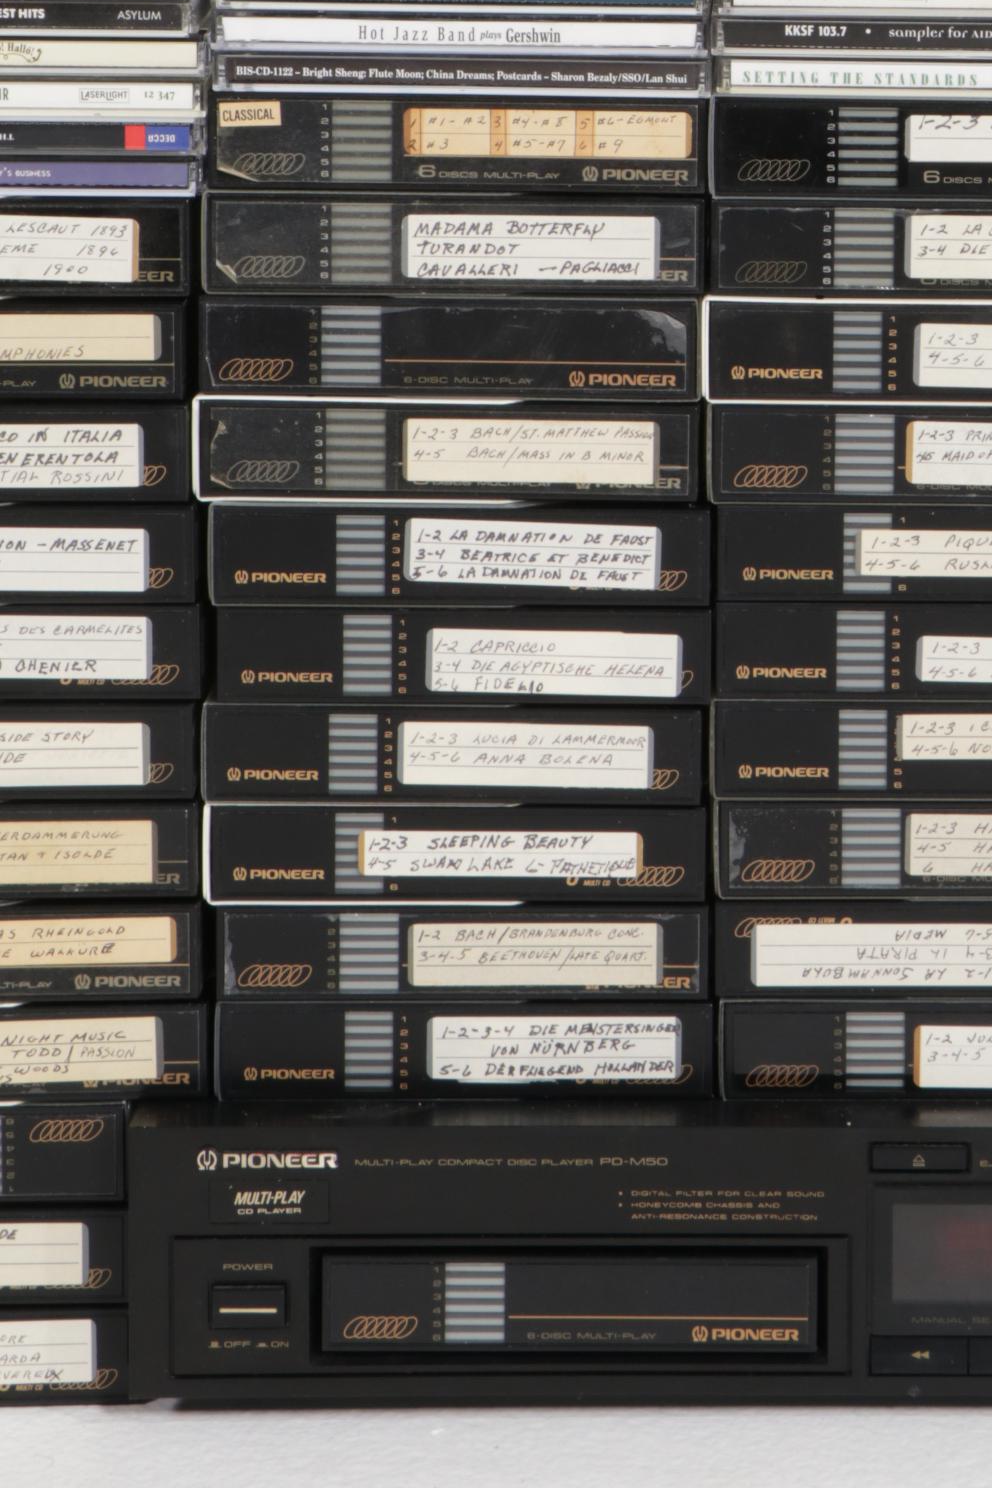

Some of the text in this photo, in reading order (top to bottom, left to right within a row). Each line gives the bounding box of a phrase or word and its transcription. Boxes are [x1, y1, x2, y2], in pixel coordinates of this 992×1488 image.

[117, 10, 161, 20] ASYLUM
[506, 27, 561, 46] Gershwin
[223, 109, 274, 121] CLASSICAL
[602, 168, 688, 182] PIONEER
[414, 222, 493, 237] MADAMA
[589, 374, 676, 386] PIONEER
[748, 368, 822, 379] PIONEER
[258, 672, 332, 682] PIONEER
[427, 834, 593, 850] SLEEPING BEAUTY
[223, 1153, 337, 1168] PIONEER
[234, 1191, 305, 1205] MULTI-PLAY
[712, 1328, 798, 1341] PIONEER
